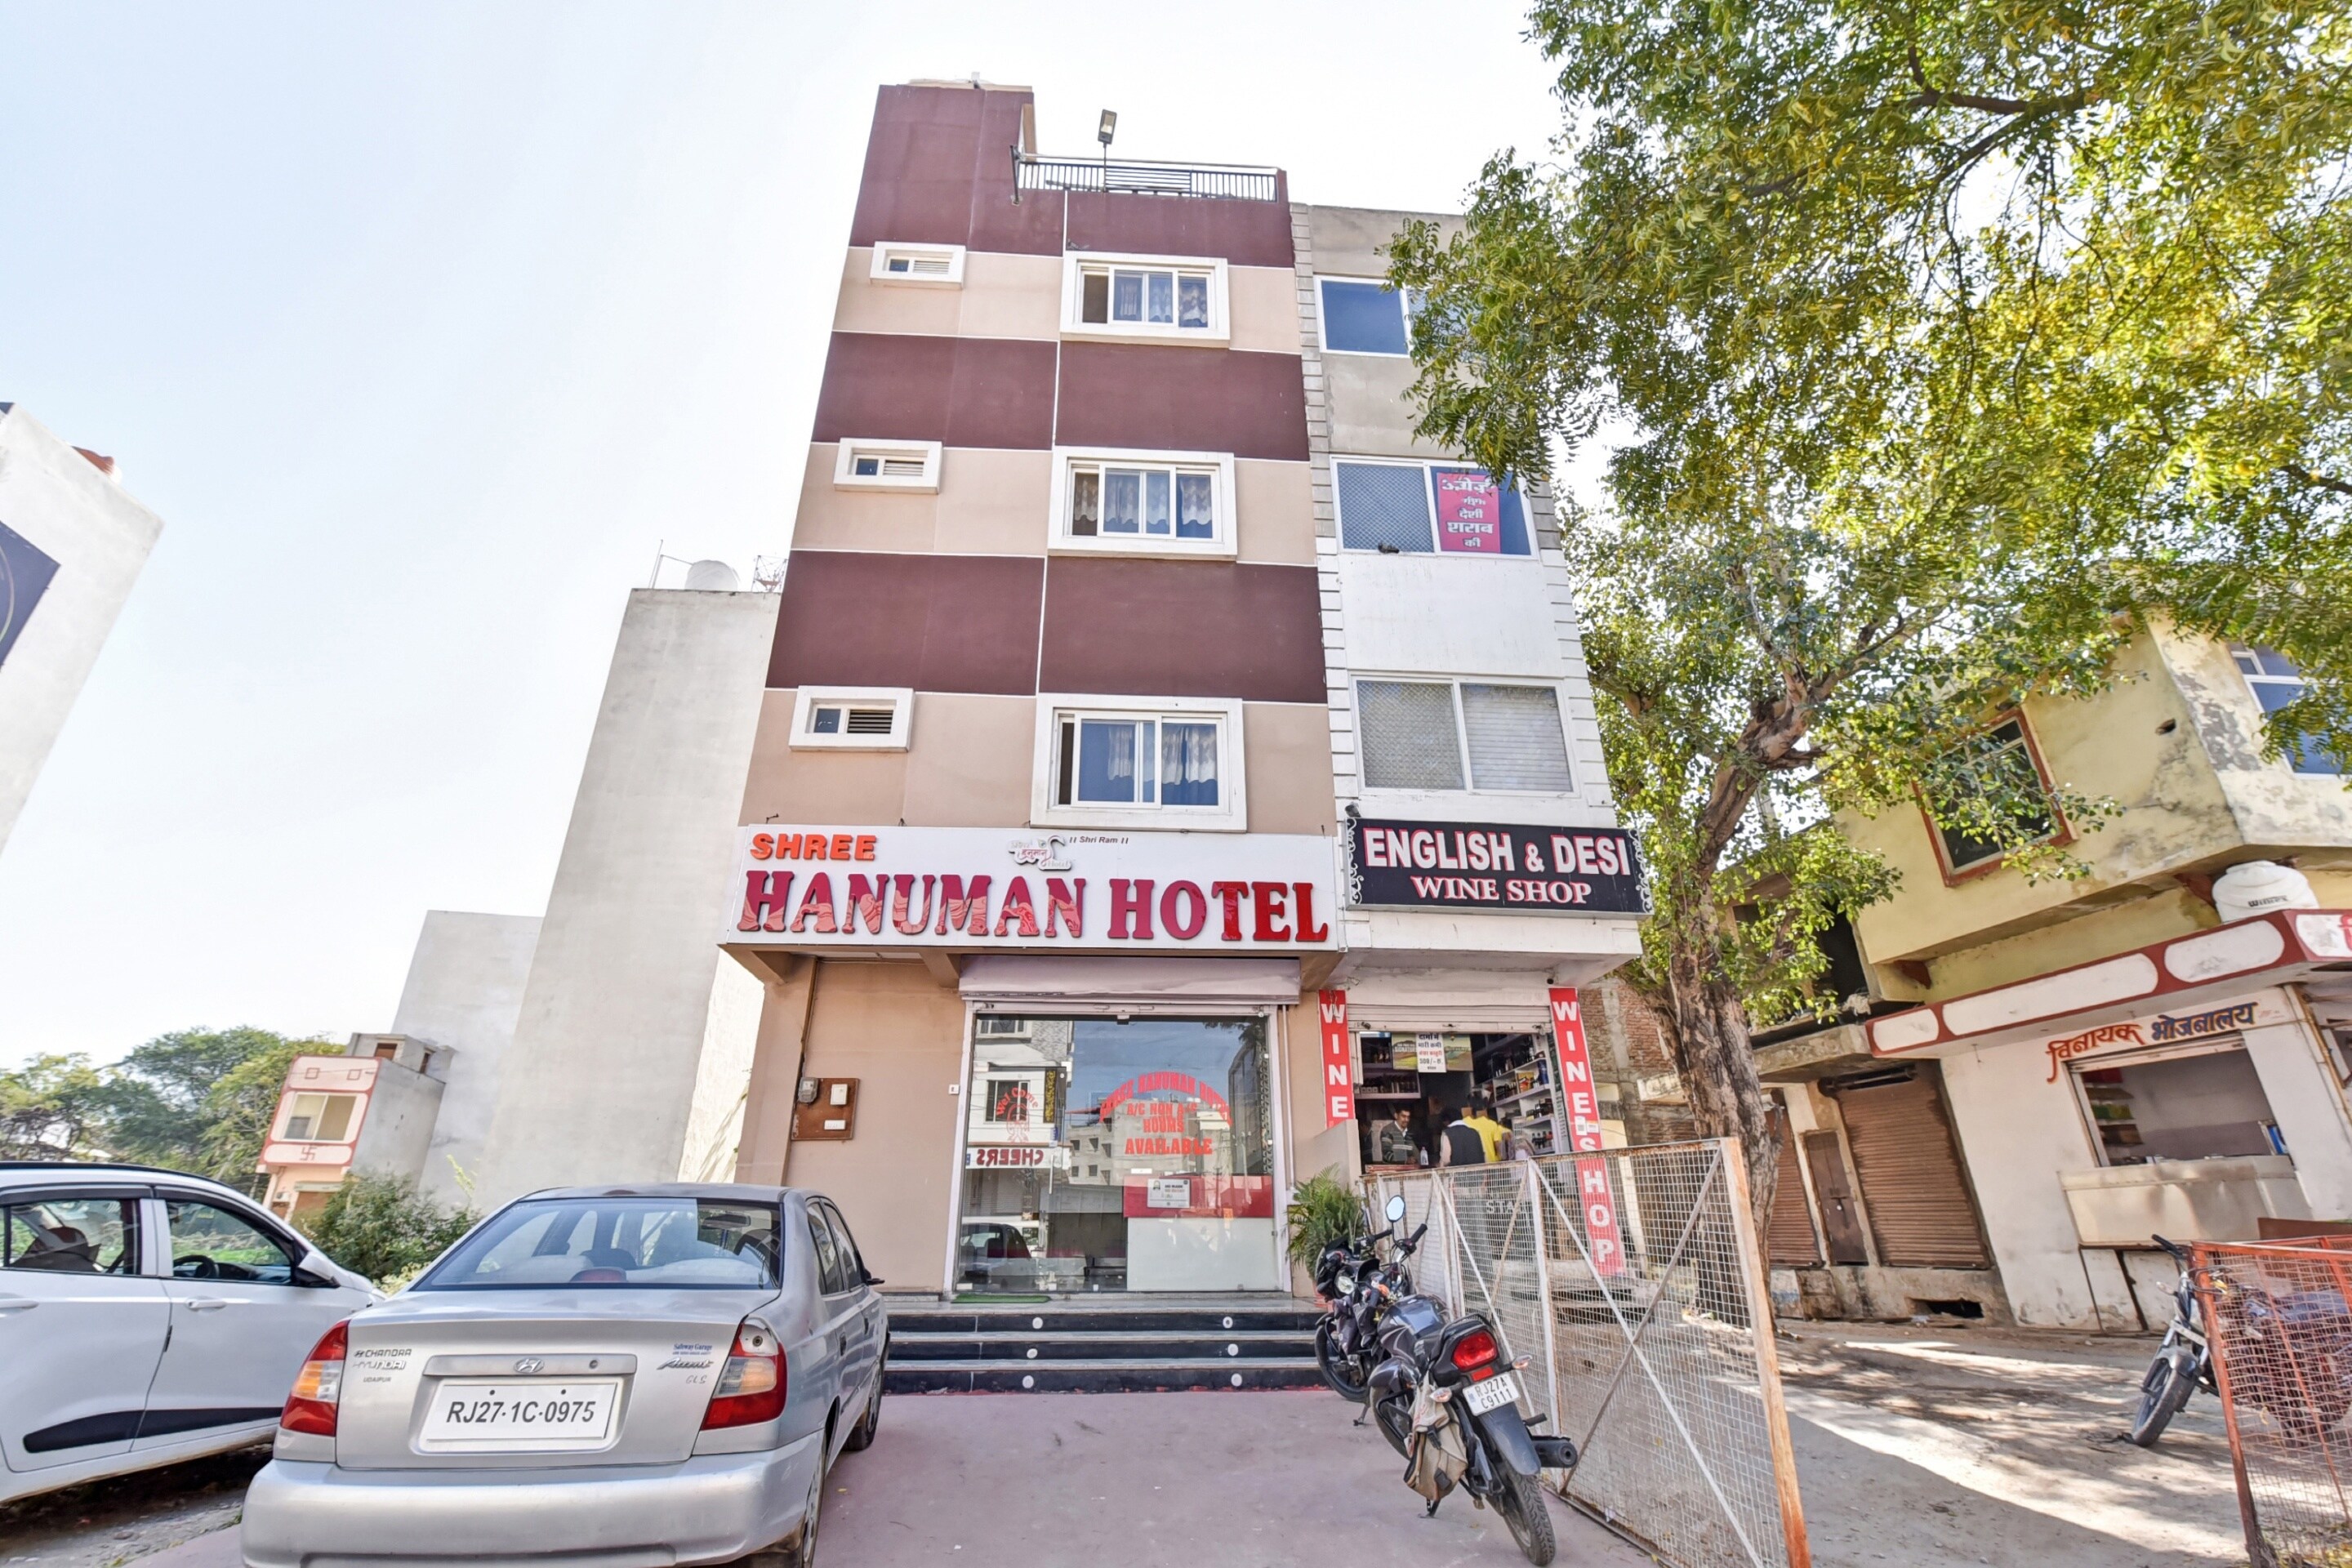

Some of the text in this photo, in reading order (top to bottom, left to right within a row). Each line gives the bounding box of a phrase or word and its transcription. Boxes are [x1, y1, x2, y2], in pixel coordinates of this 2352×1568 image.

[1459, 508, 1483, 519] देशी
[1446, 522, 1494, 533] शराब
[1463, 537, 1481, 547] की
[750, 833, 877, 860] SHREE
[1363, 826, 1631, 875] ENGLISH & DESI
[1410, 875, 1592, 904] WINE SHOP
[737, 871, 1328, 942] HANUMAN HOTEL
[2151, 1002, 2259, 1041] भोजनालय
[1321, 1004, 1348, 1118] WINE
[1553, 1001, 1592, 1114] WINE
[996, 1092, 1011, 1116] Wel
[1125, 1138, 1213, 1155] AVAILABLE
[365, 1348, 412, 1357] CHANDRA
[353, 1361, 407, 1370] HYUNDAI
[1474, 1376, 1508, 1397] RJ27A
[1480, 1388, 1513, 1409] C9111
